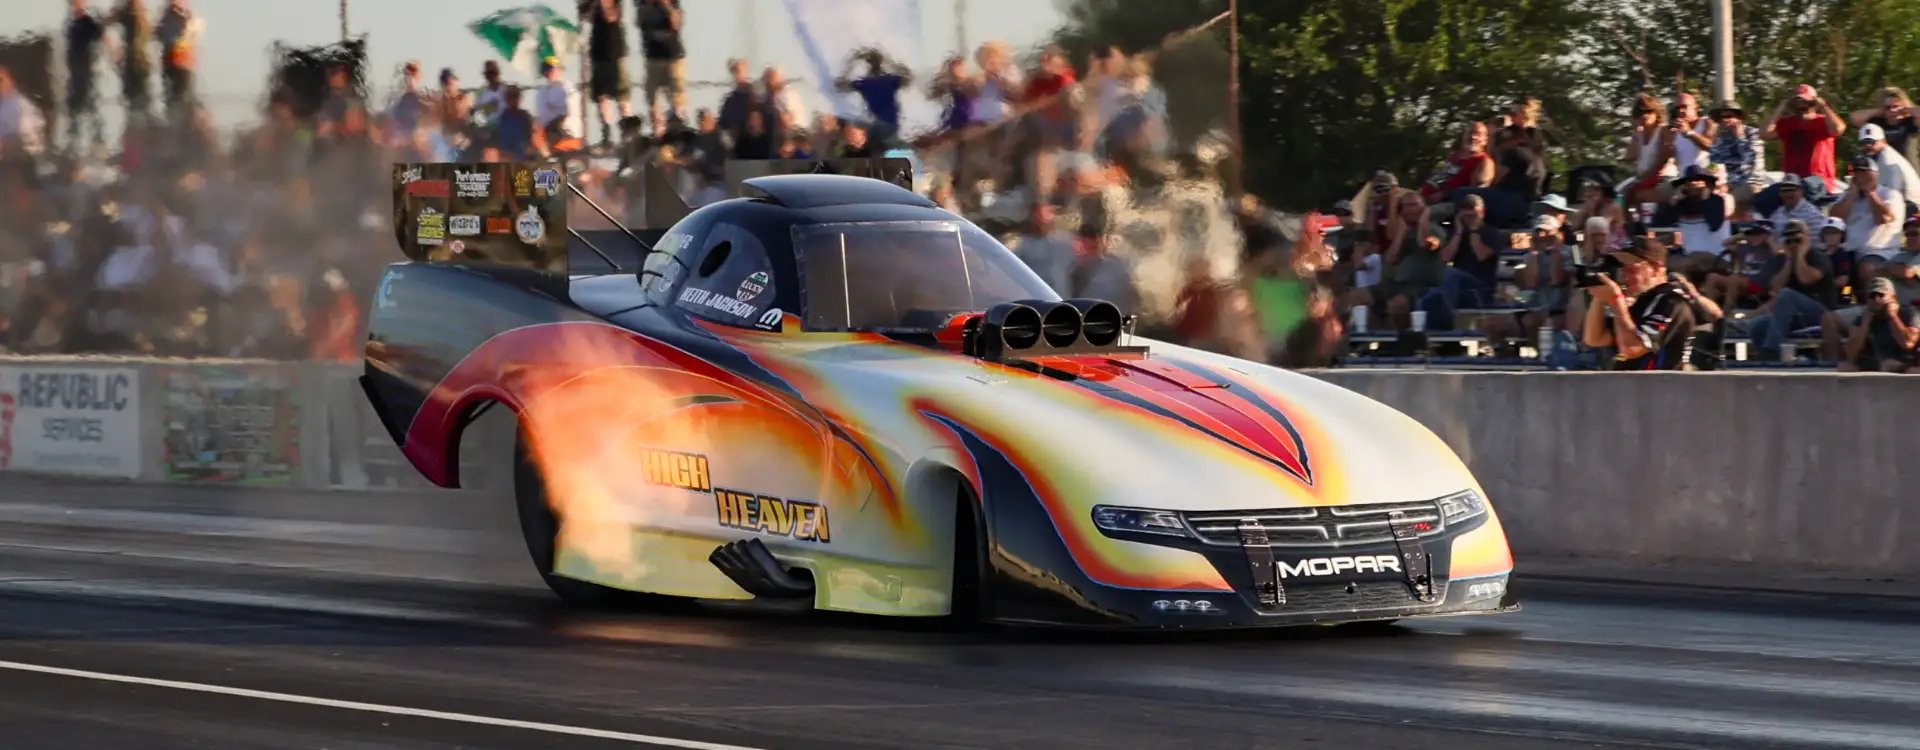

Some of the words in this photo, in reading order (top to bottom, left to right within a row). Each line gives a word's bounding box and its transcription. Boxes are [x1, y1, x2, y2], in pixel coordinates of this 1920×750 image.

[678, 287, 711, 304] KEITH
[705, 293, 759, 319] JACKSON
[19, 372, 129, 412] REPUBLIC
[640, 449, 711, 493] HIGH
[714, 488, 831, 543] HEAVEN
[1276, 554, 1402, 579] MOPAR
